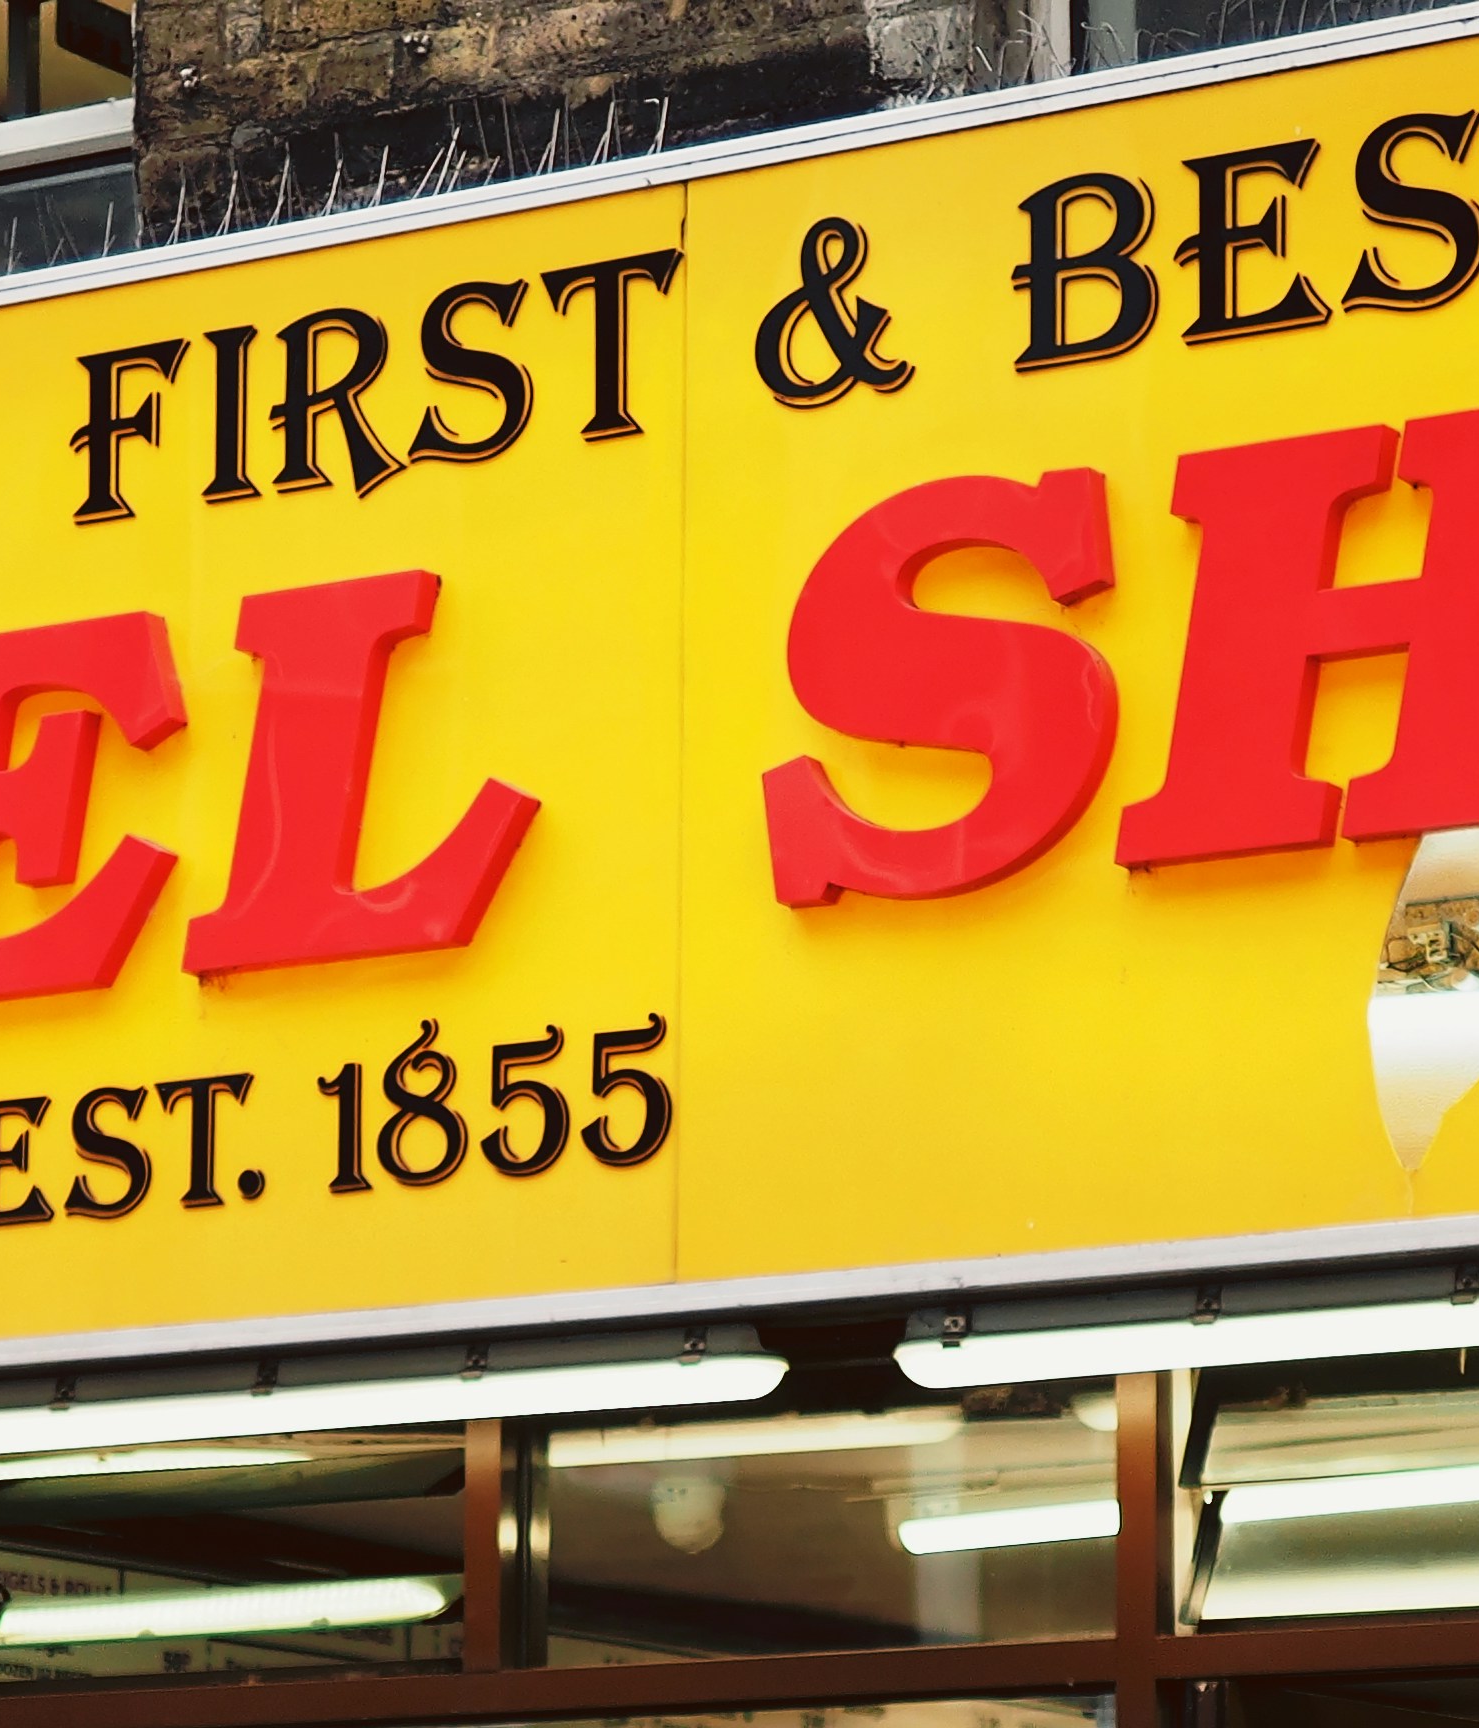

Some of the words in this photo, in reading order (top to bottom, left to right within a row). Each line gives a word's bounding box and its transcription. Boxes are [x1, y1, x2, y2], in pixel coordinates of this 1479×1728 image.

[69, 247, 686, 529] FIRST
[753, 215, 917, 411] &
[316, 1012, 674, 1195] 1855
